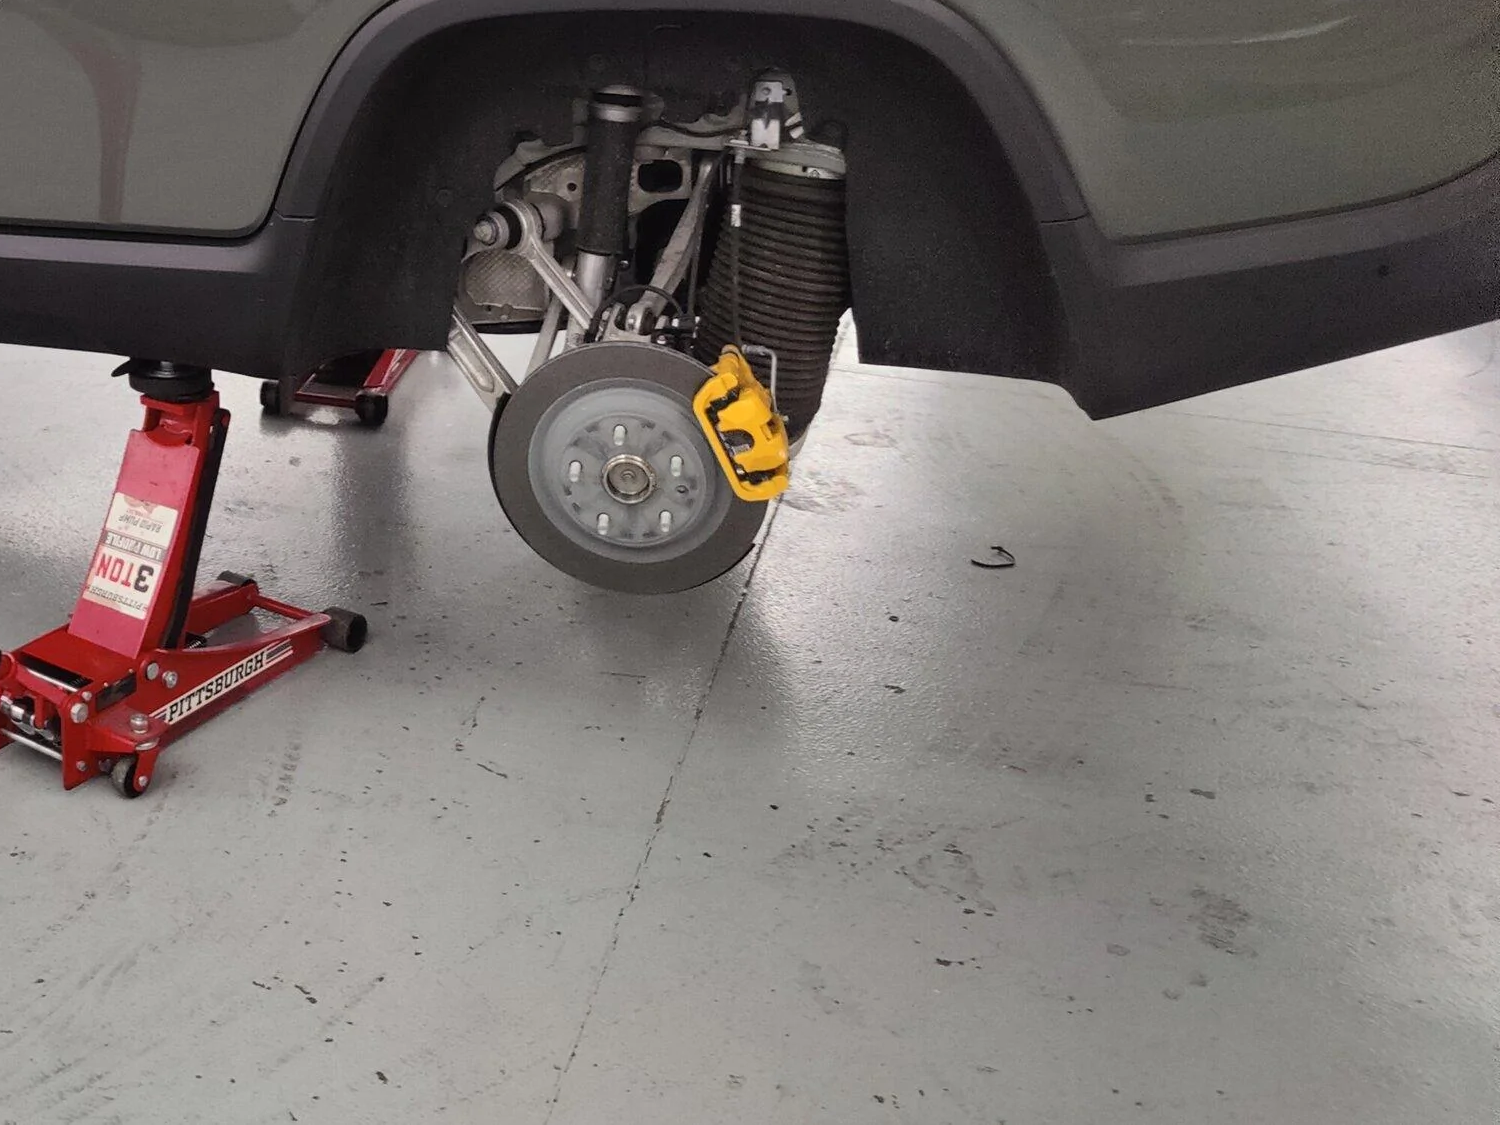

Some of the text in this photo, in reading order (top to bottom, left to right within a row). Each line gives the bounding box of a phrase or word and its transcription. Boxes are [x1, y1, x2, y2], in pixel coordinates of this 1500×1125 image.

[95, 553, 155, 594] 3 TON
[168, 650, 266, 723] PITTSBURGH
